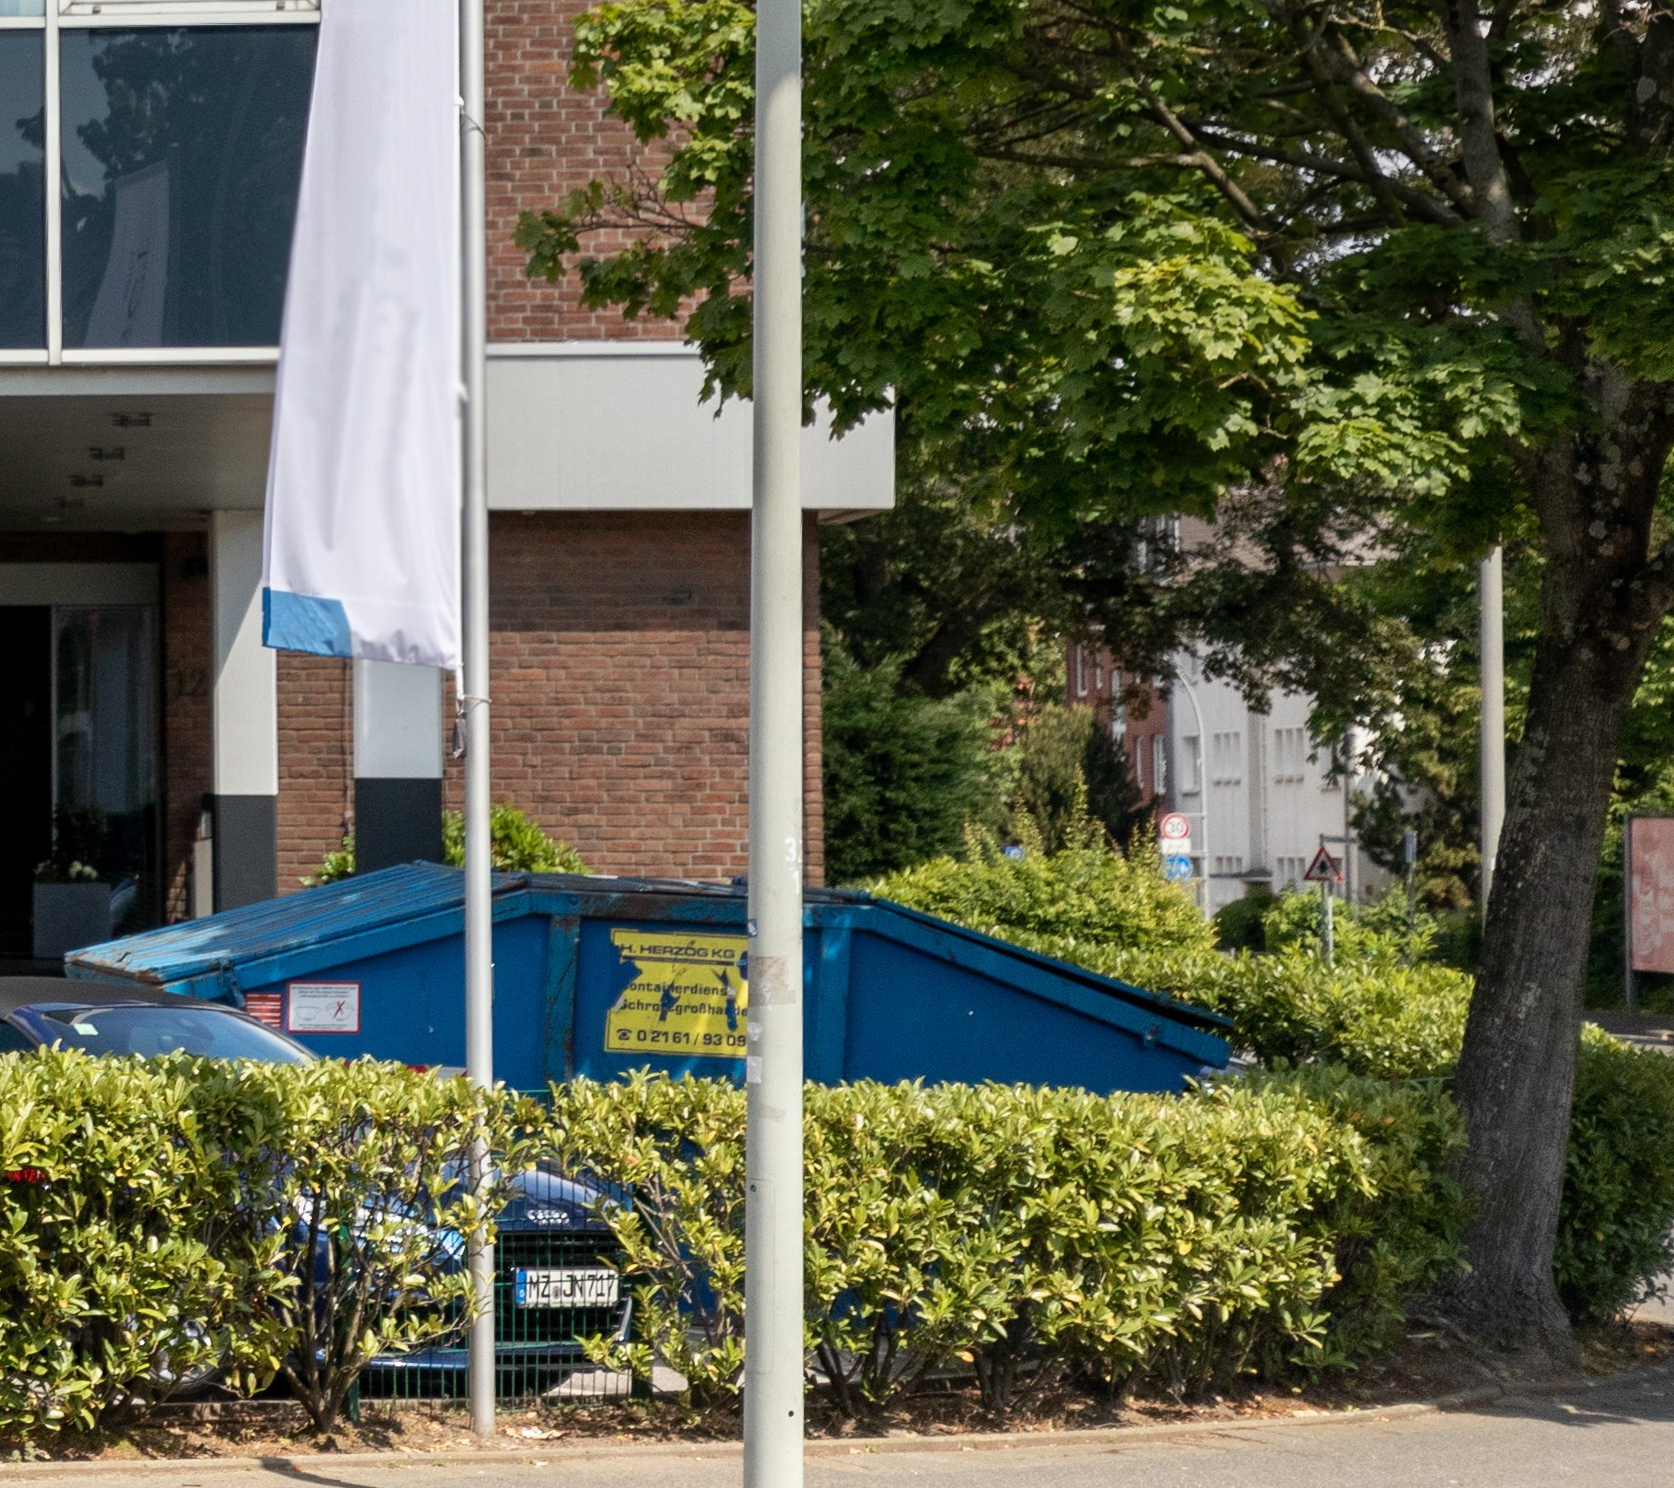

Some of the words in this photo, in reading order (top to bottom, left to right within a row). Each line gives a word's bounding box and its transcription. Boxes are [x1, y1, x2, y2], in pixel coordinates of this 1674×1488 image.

[174, 668, 208, 696] 12
[620, 943, 637, 954] H.
[639, 944, 708, 958] HERZOG
[711, 948, 736, 959] KG
[702, 1033, 723, 1046] 93
[726, 1034, 747, 1047] 09
[528, 1274, 551, 1299] MZ
